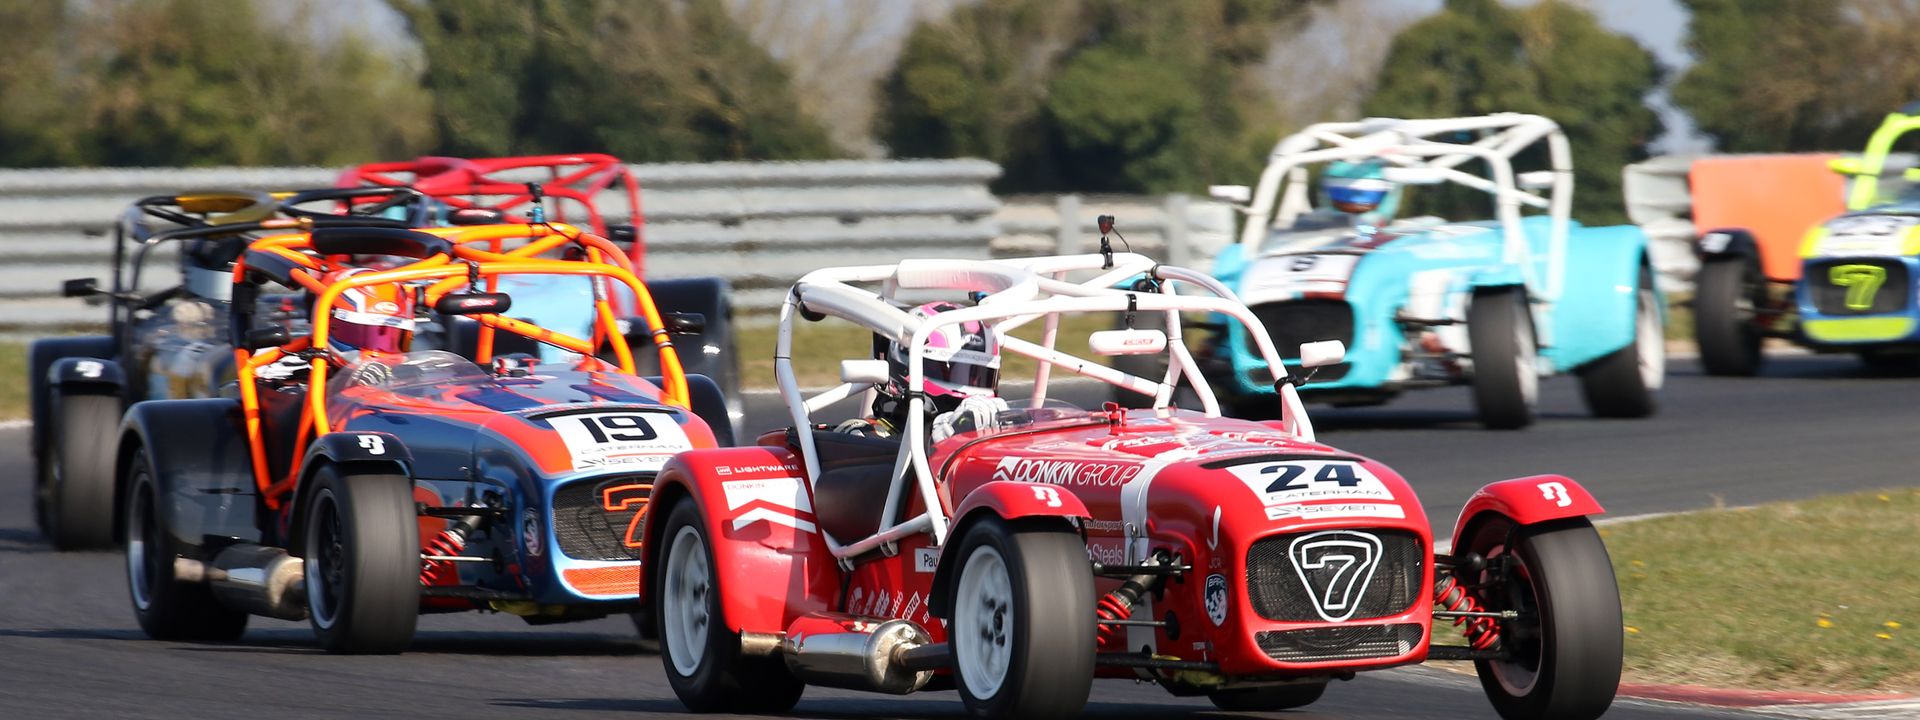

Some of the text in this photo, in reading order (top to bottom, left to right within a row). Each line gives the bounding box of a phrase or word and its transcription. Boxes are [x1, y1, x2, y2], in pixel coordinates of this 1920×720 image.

[1828, 264, 1887, 310] 7
[579, 415, 658, 443] 19
[580, 444, 683, 455] CATERHAM
[734, 464, 799, 474] LIGHTWARE
[1014, 459, 1142, 487] DONKIN GROUP
[1260, 464, 1363, 494] 24
[1271, 490, 1382, 501] CATERHAM
[1304, 505, 1377, 513] SEVEN
[923, 553, 940, 568] Pau
[1302, 540, 1372, 610] 7
